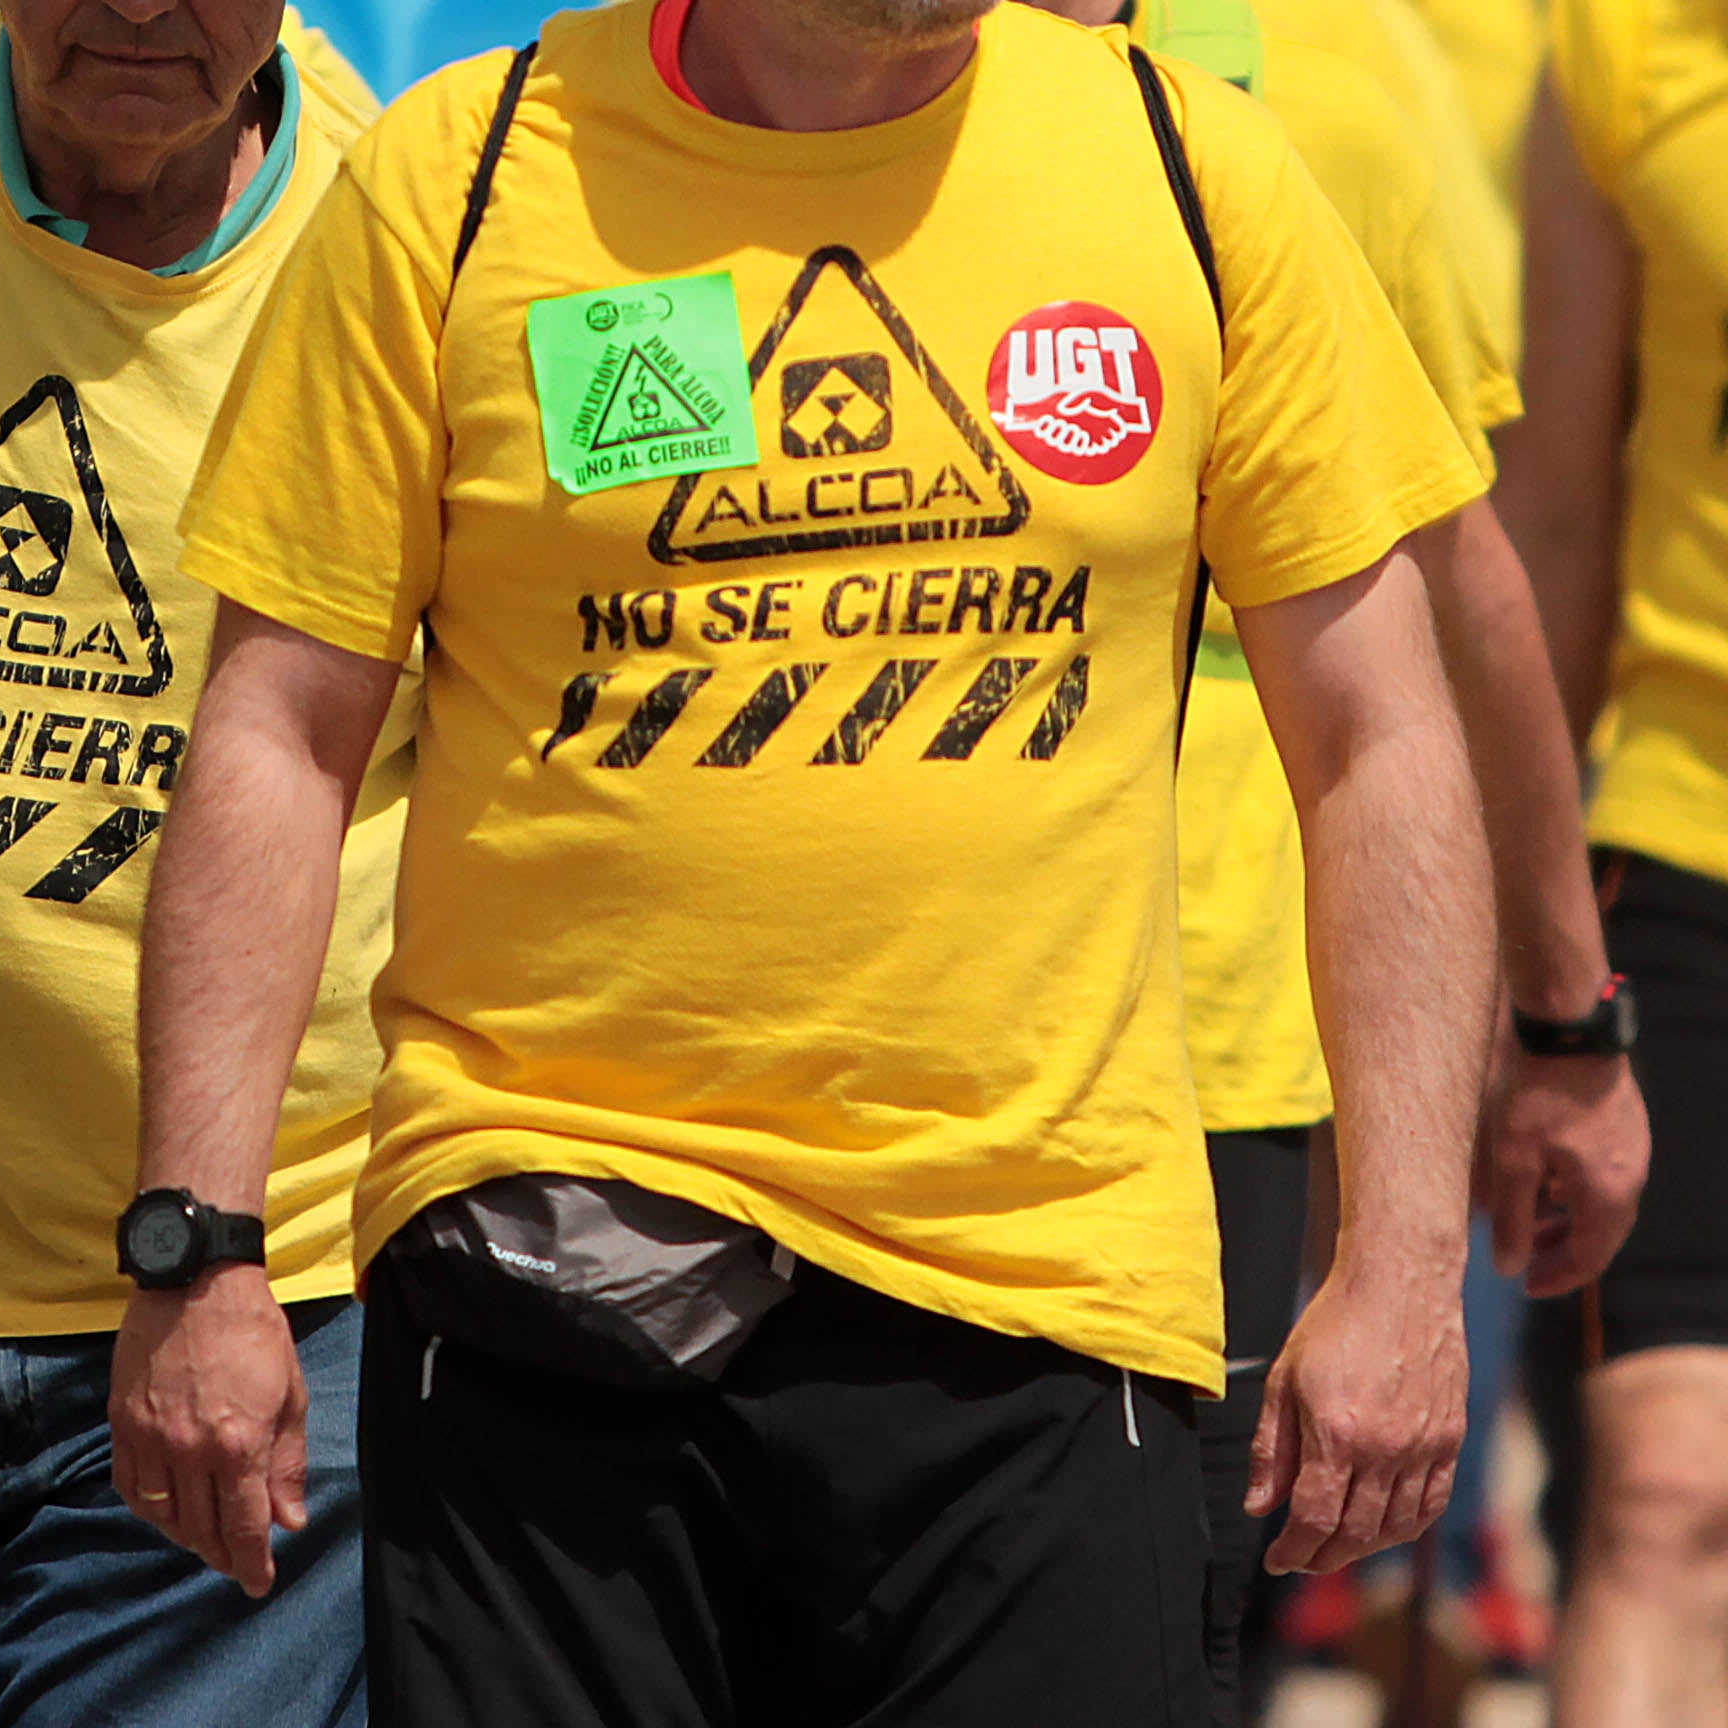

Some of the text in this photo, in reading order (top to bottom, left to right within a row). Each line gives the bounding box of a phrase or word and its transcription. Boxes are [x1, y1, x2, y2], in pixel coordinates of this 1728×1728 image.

[644, 335, 727, 424] PARA ALCOA
[1006, 326, 1140, 403] UGT
[617, 417, 682, 439] ALCOA
[619, 451, 643, 470] AL
[695, 464, 983, 532] ALCOA
[579, 566, 1091, 651] NO SE CIERRA
